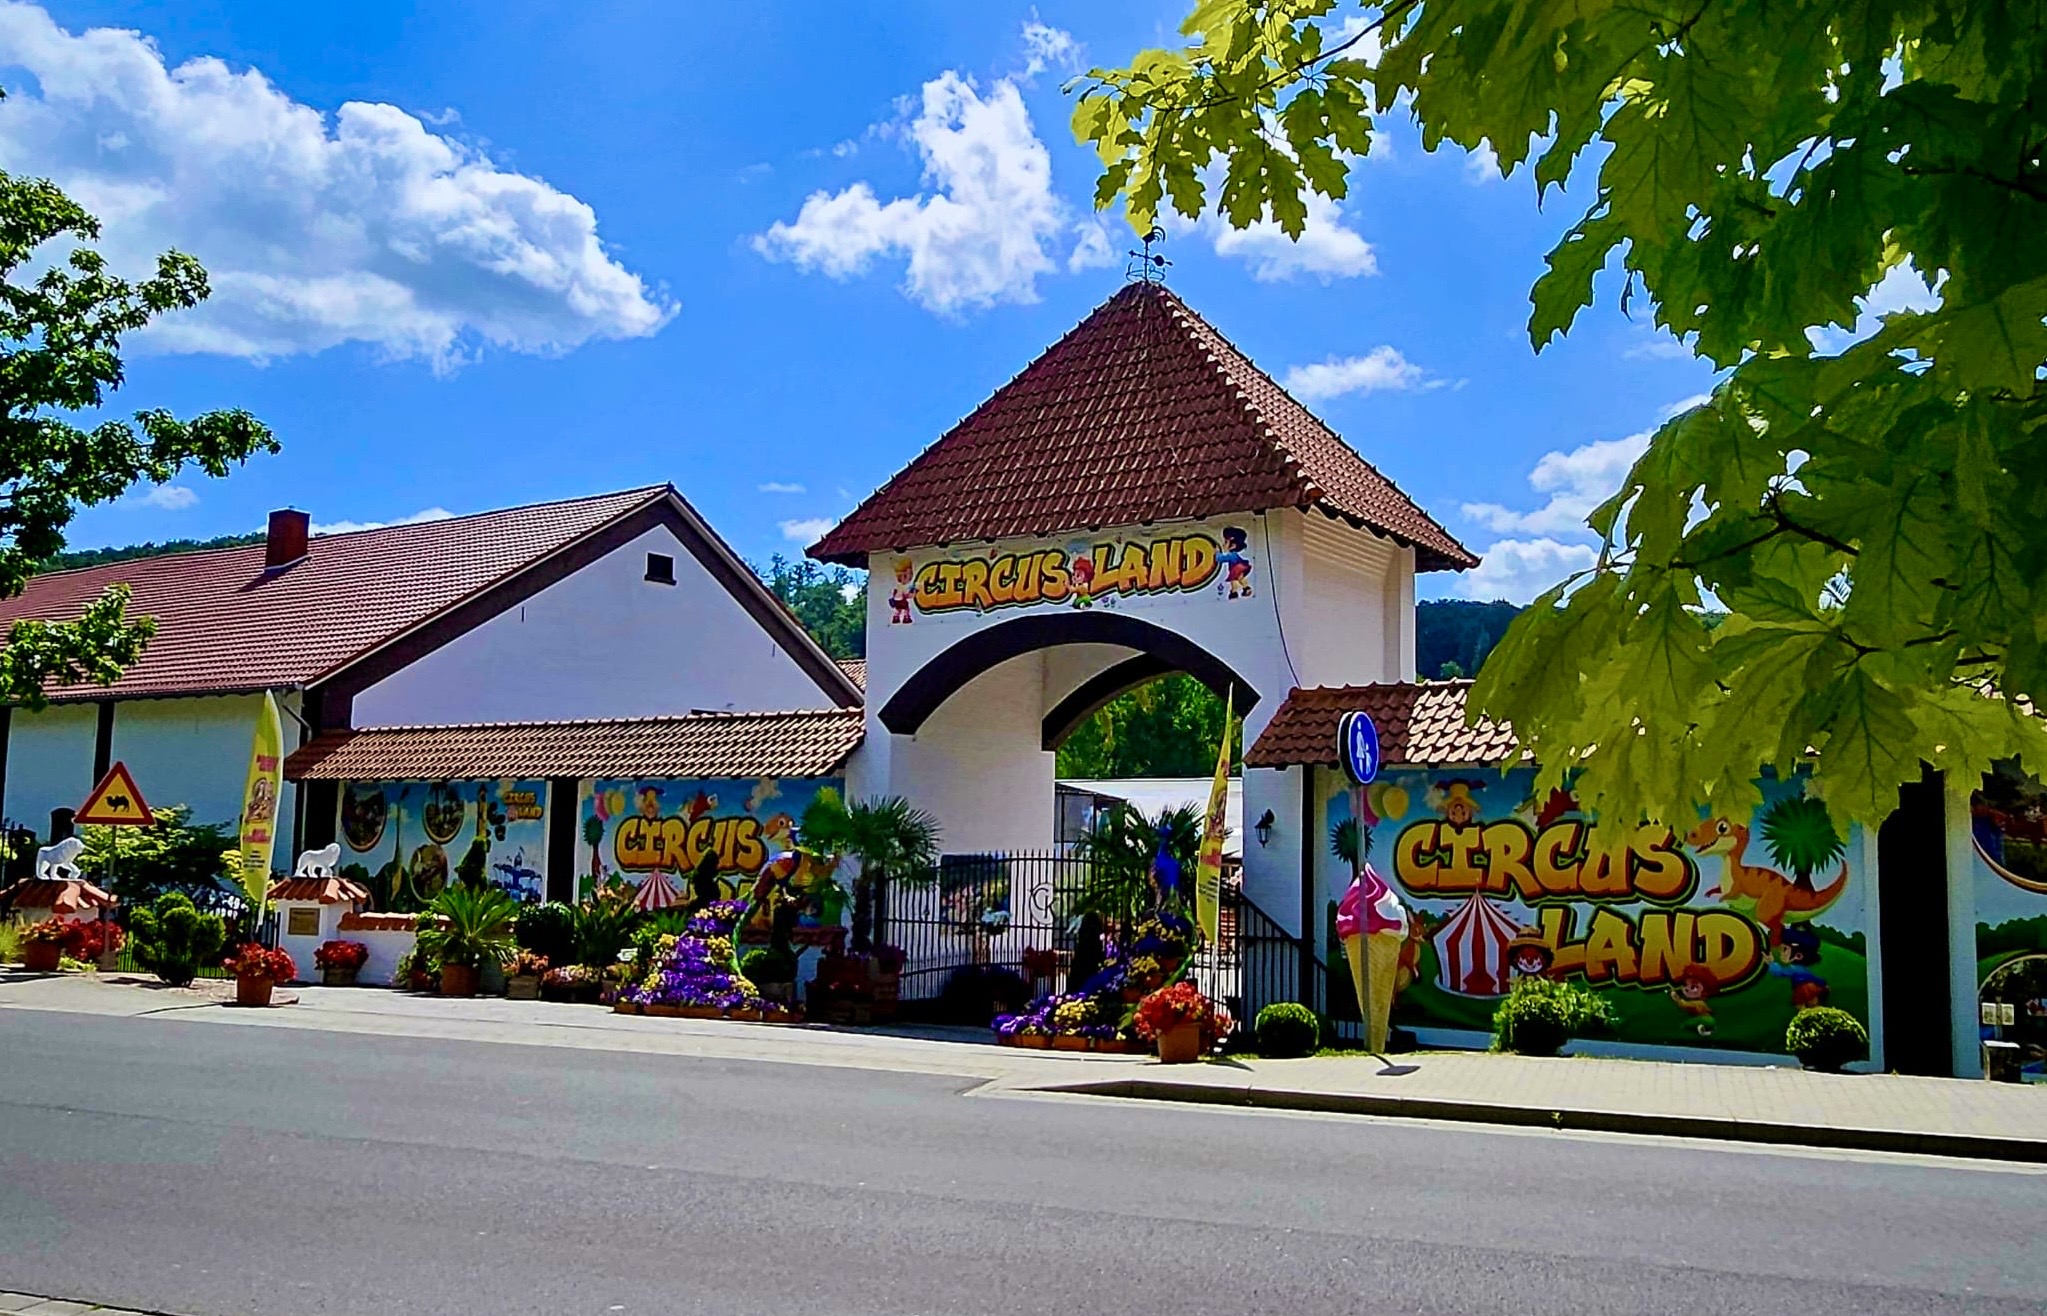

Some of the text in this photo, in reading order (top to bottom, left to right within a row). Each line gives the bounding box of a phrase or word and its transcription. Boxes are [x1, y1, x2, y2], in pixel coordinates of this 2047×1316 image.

[915, 535, 1217, 612] CIRCUS LAND
[615, 816, 766, 873] CIRCUS
[1396, 821, 1694, 897] CIRCUS
[1541, 906, 1758, 986] LAND
